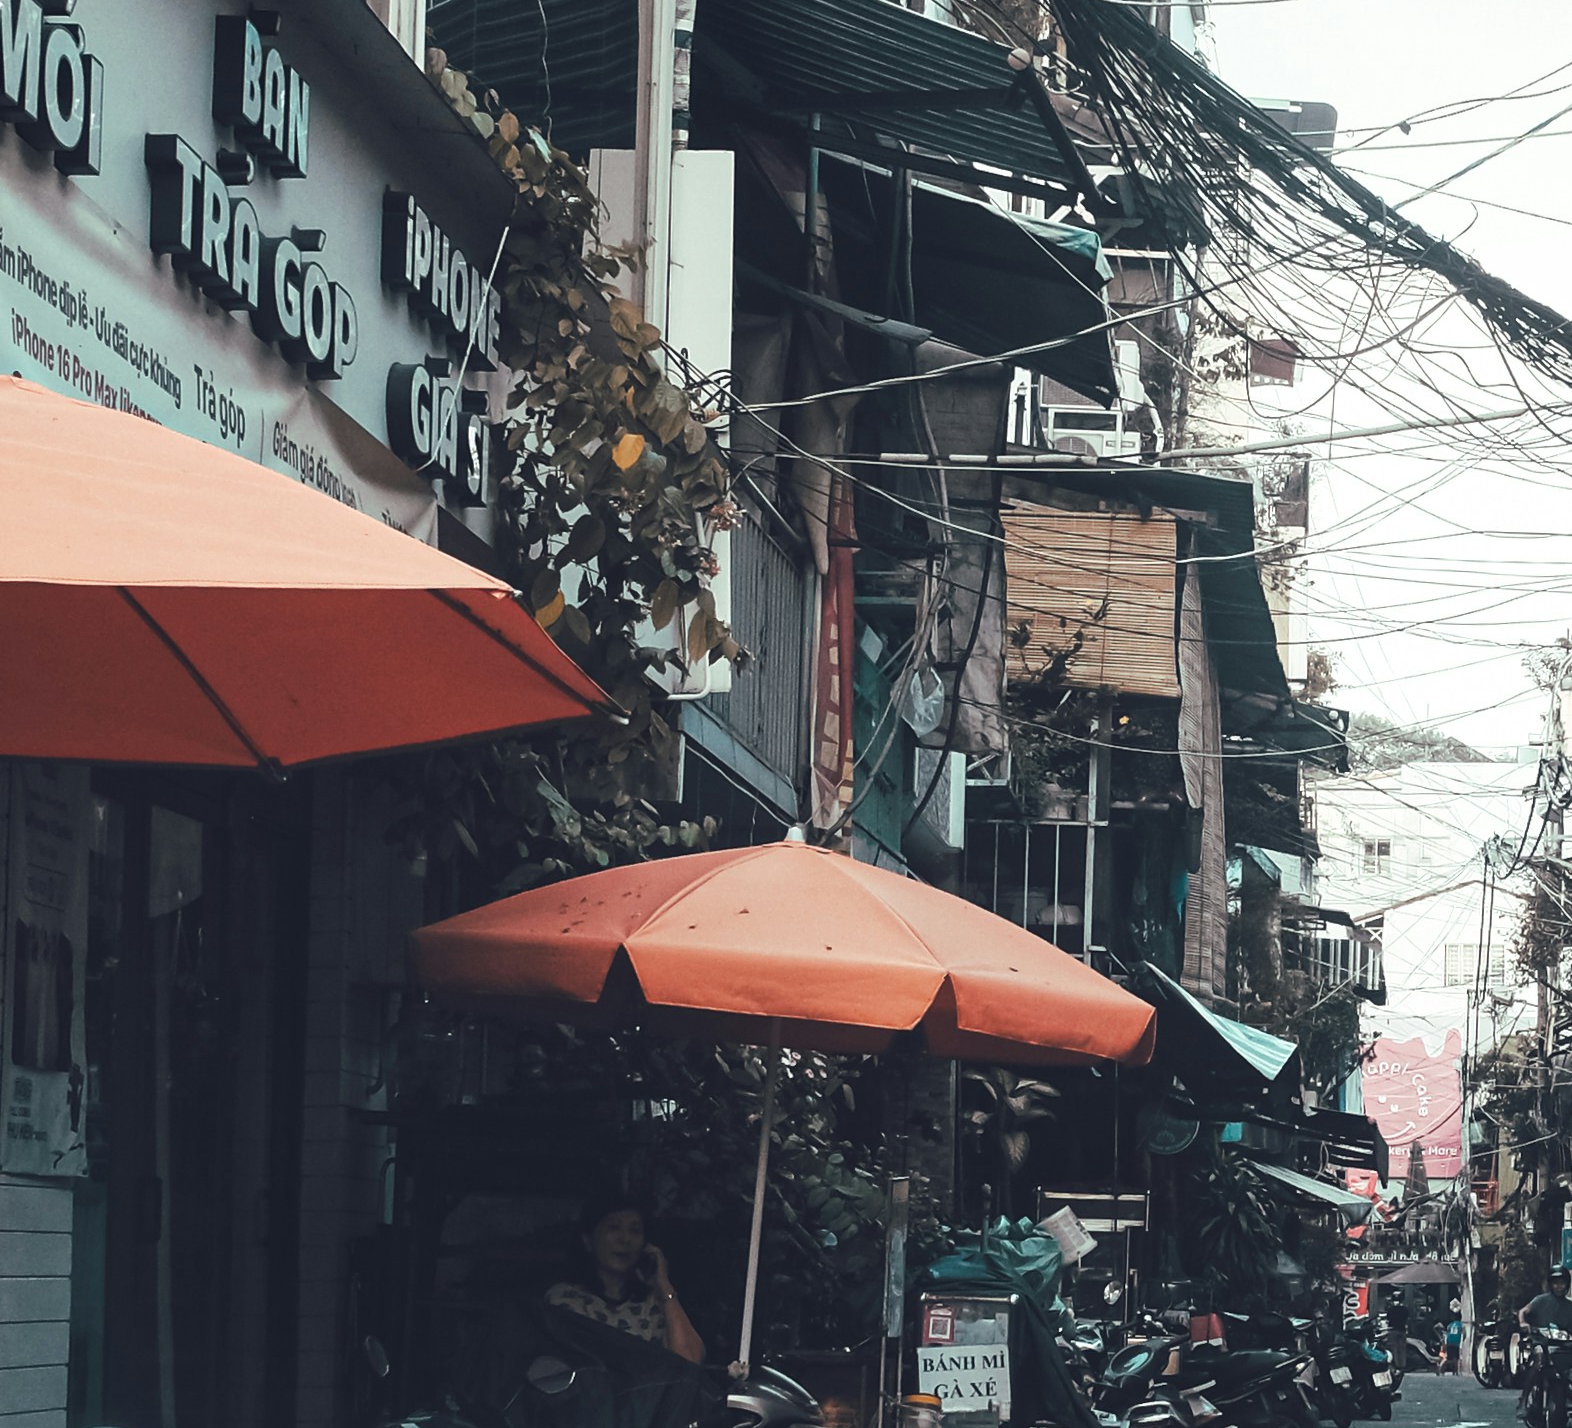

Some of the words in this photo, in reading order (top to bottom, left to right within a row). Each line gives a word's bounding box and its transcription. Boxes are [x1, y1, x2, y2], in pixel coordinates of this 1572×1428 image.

[243, 11, 311, 179] BÁN
[18, 245, 57, 308] iPhone
[274, 229, 358, 380] GÓP
[12, 307, 54, 371] iPhone
[57, 344, 70, 382] 16
[72, 354, 93, 397] Pro
[95, 370, 118, 410] Max
[194, 363, 217, 421] Trả
[220, 388, 246, 449] góp
[923, 1353, 976, 1373] BÁNH
[982, 1350, 1006, 1370] MÌ
[935, 1379, 965, 1399] GÀ
[970, 1376, 998, 1398] XÉ
